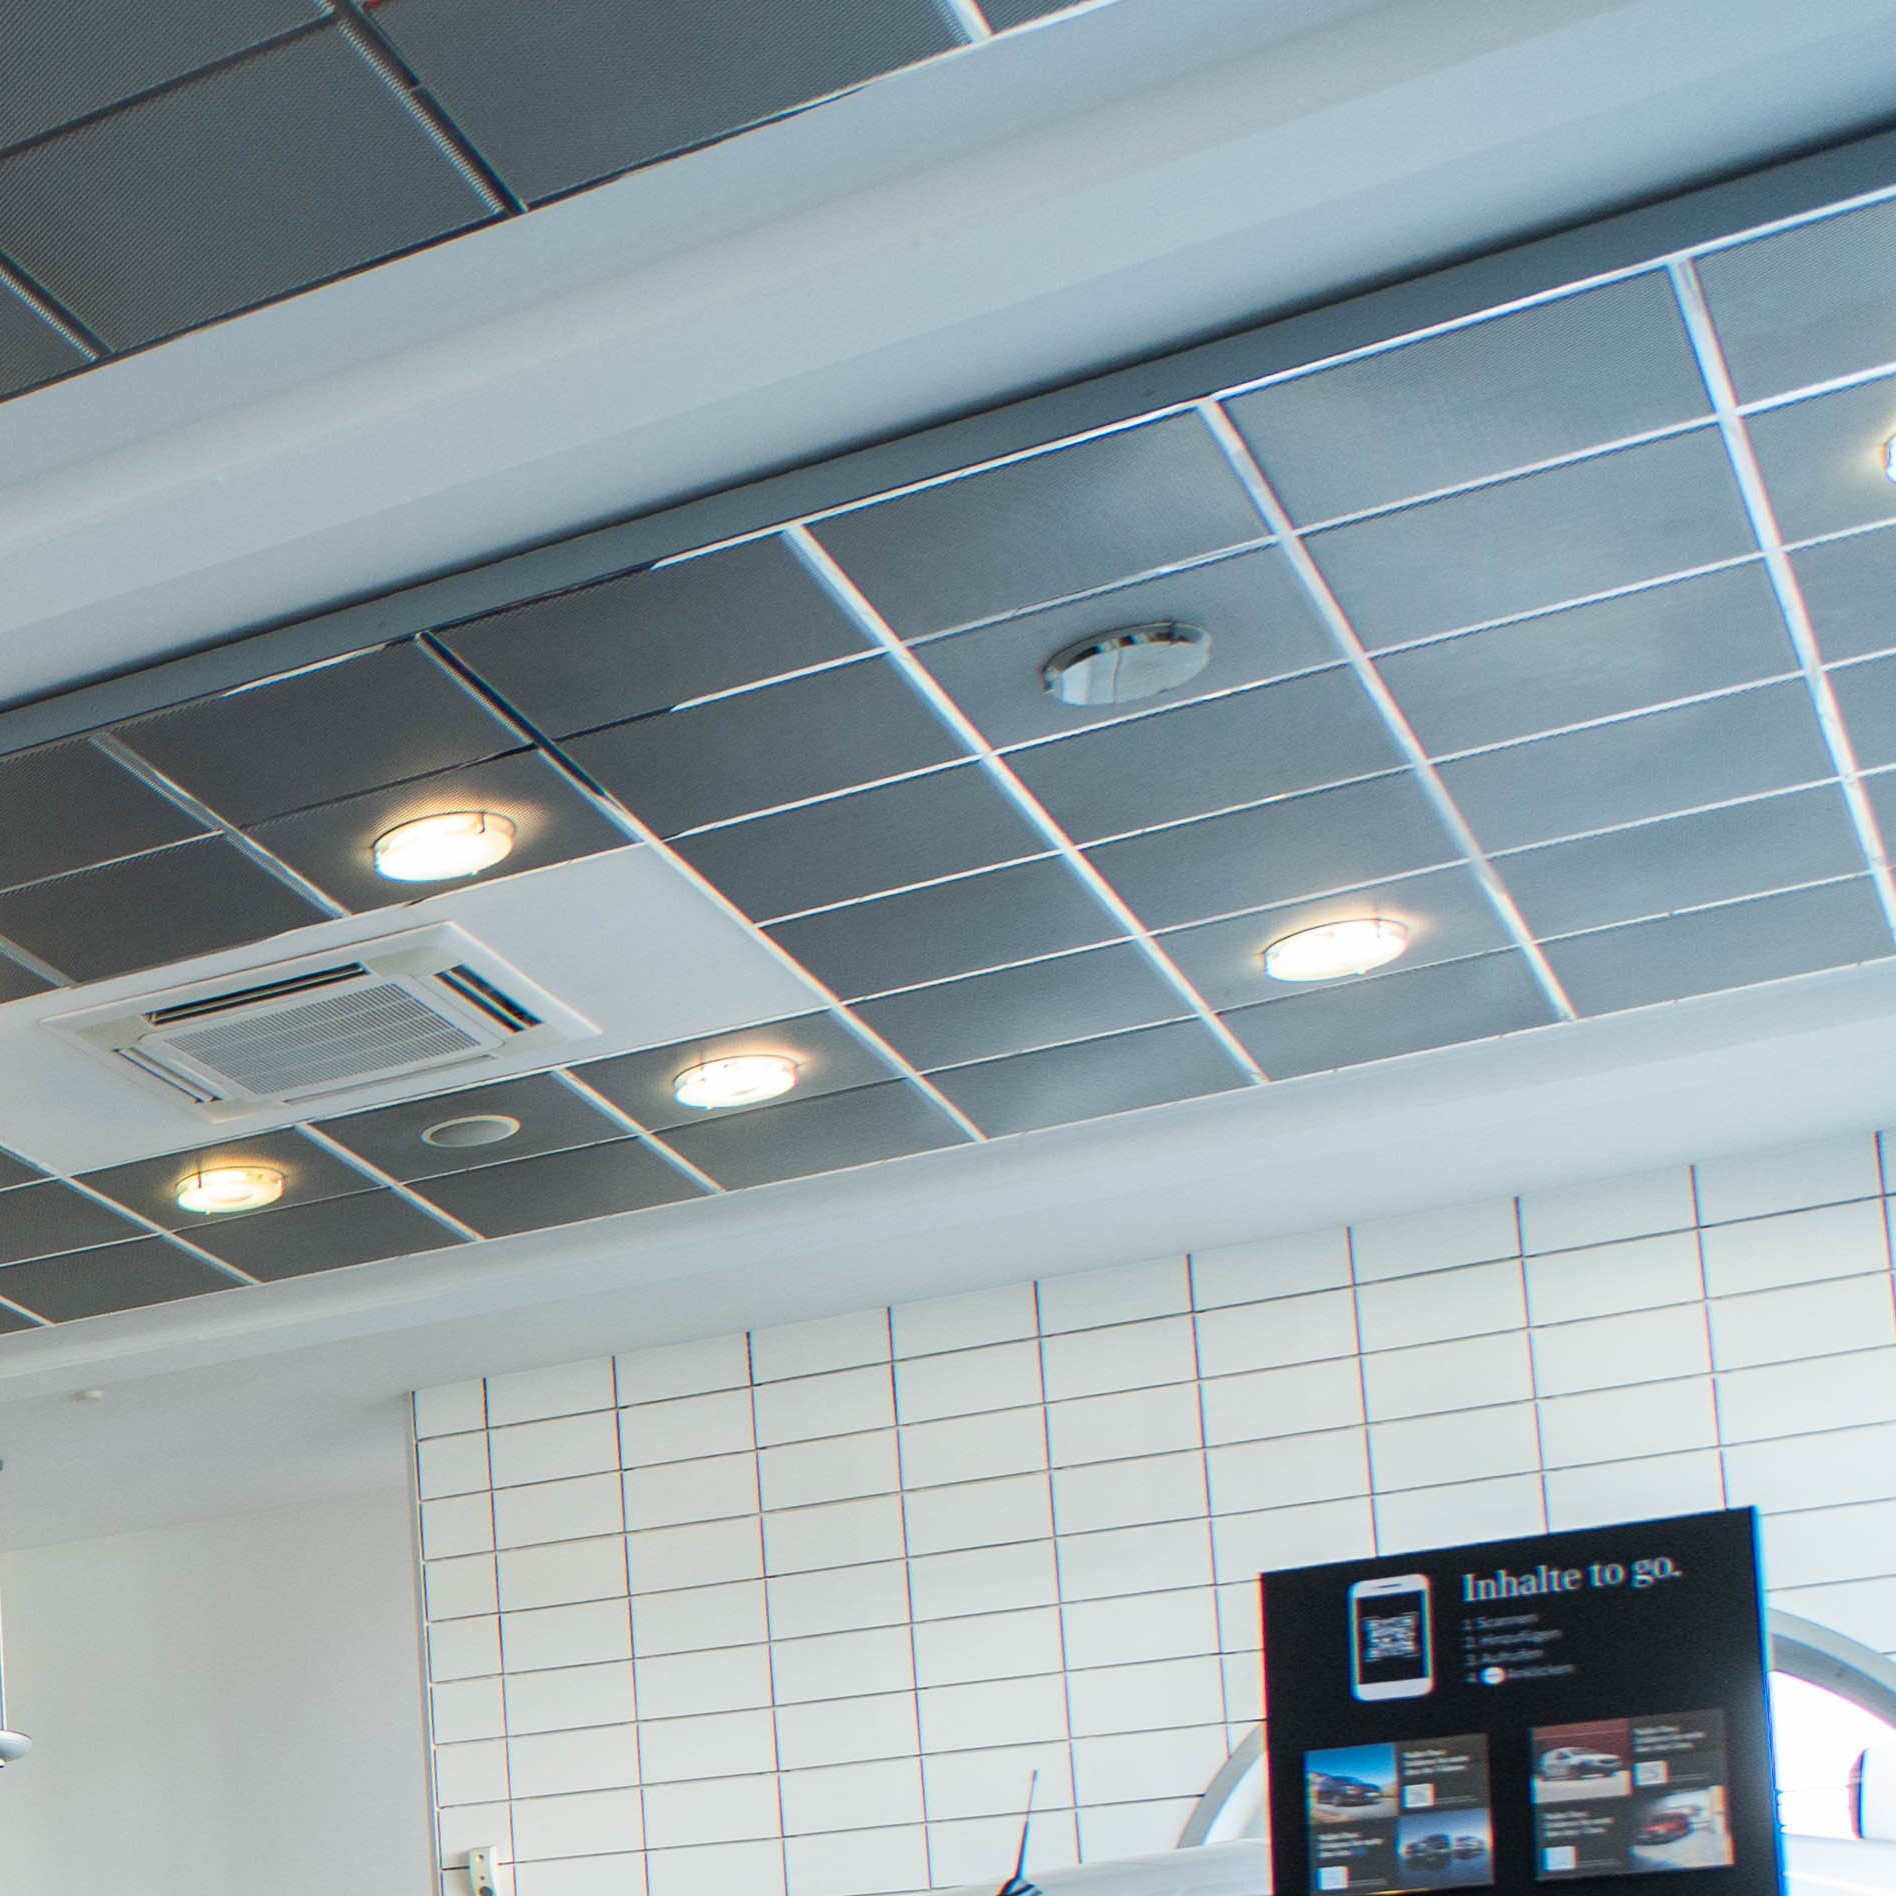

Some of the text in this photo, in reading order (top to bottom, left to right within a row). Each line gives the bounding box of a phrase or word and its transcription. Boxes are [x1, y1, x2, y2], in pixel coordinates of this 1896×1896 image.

[1461, 1556, 1683, 1602] Inhalte to go.
